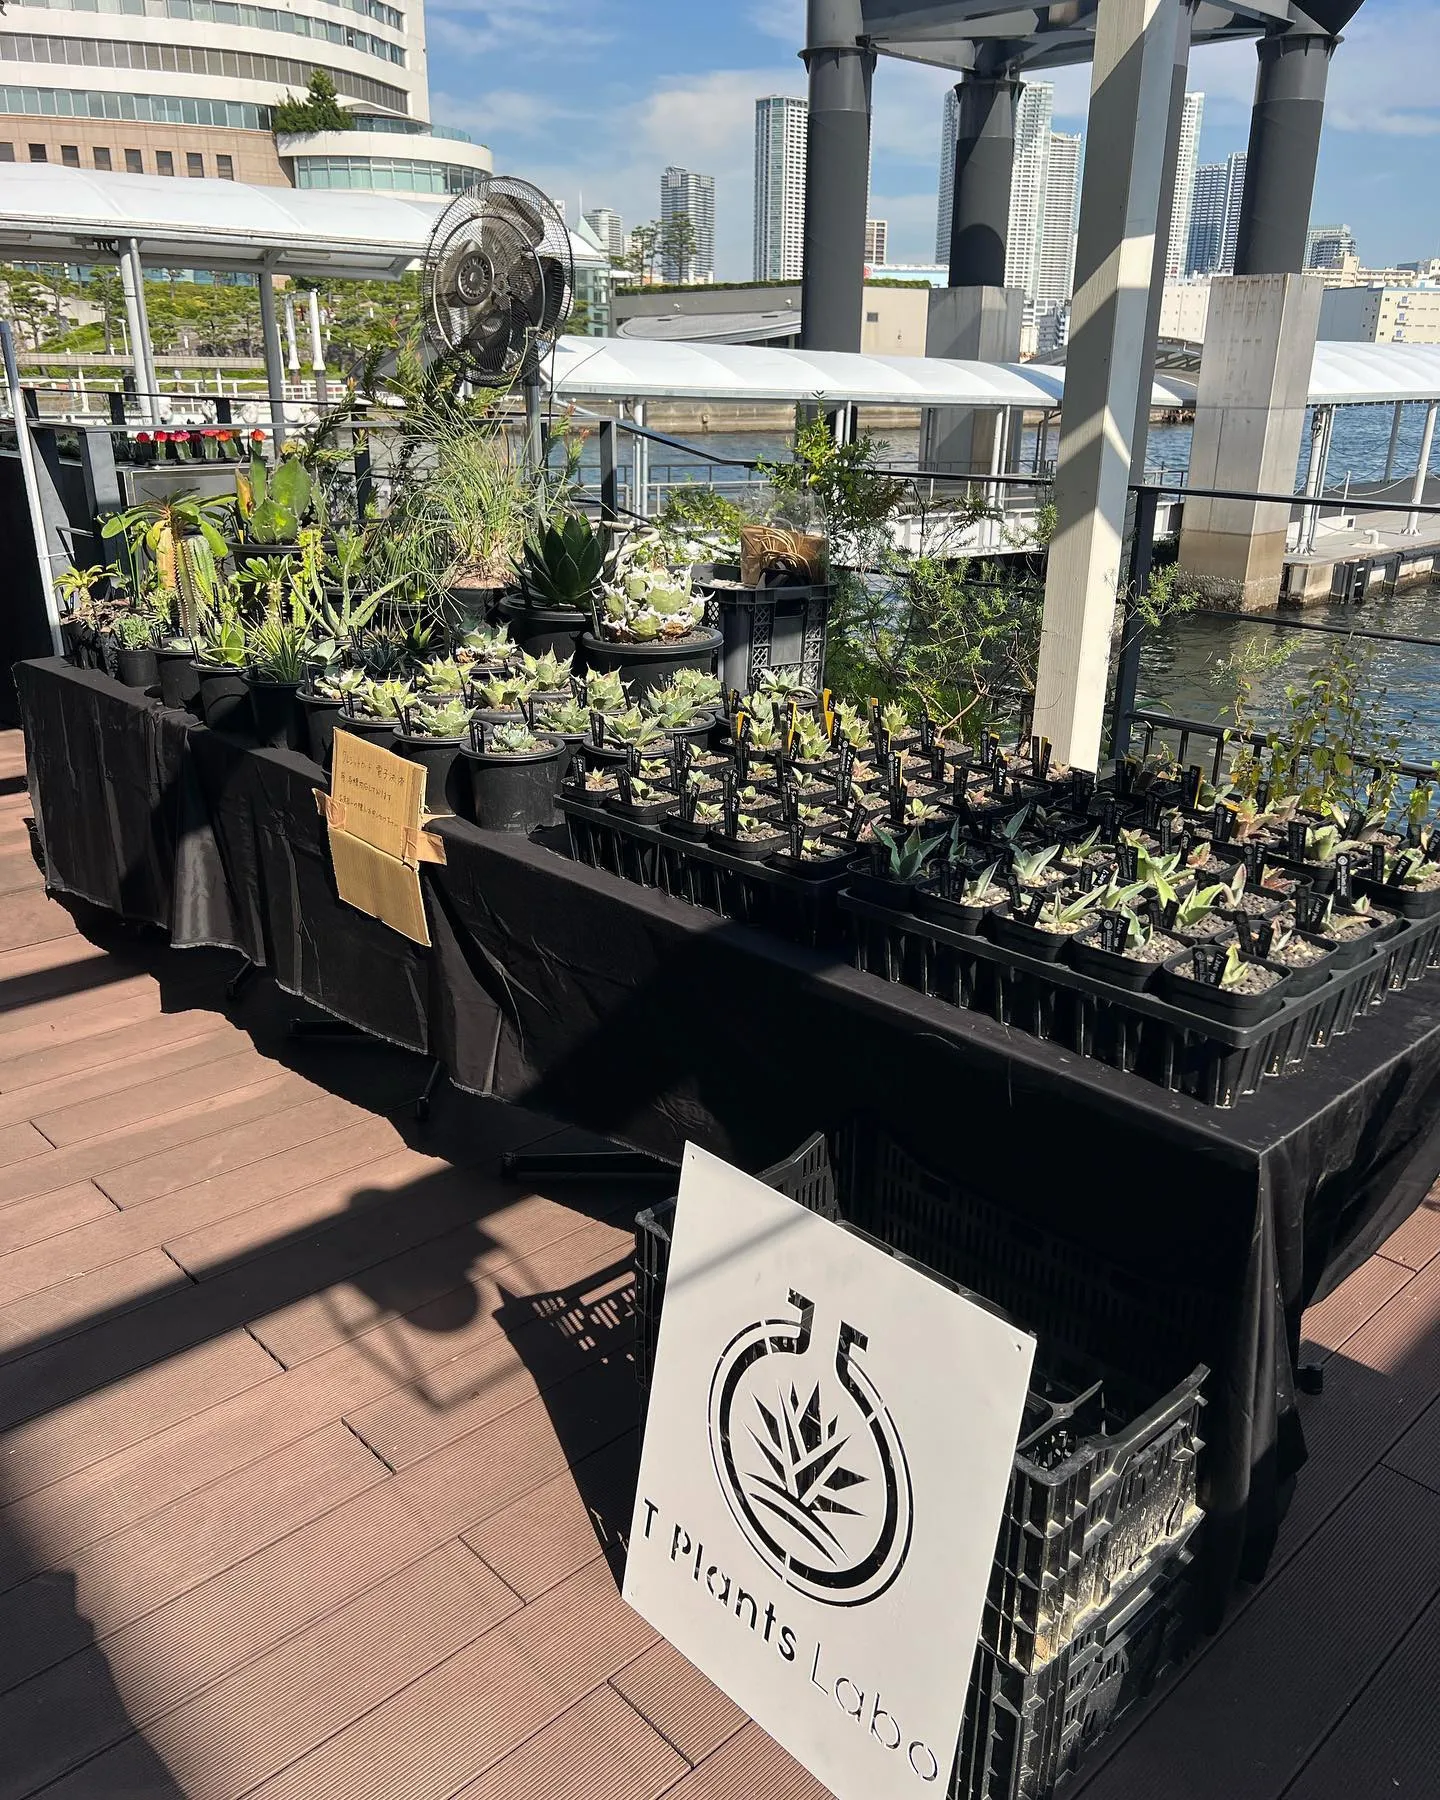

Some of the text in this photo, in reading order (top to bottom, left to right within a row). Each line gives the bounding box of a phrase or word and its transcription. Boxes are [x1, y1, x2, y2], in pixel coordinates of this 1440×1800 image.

[641, 1498, 939, 1782] T Plants Labo
